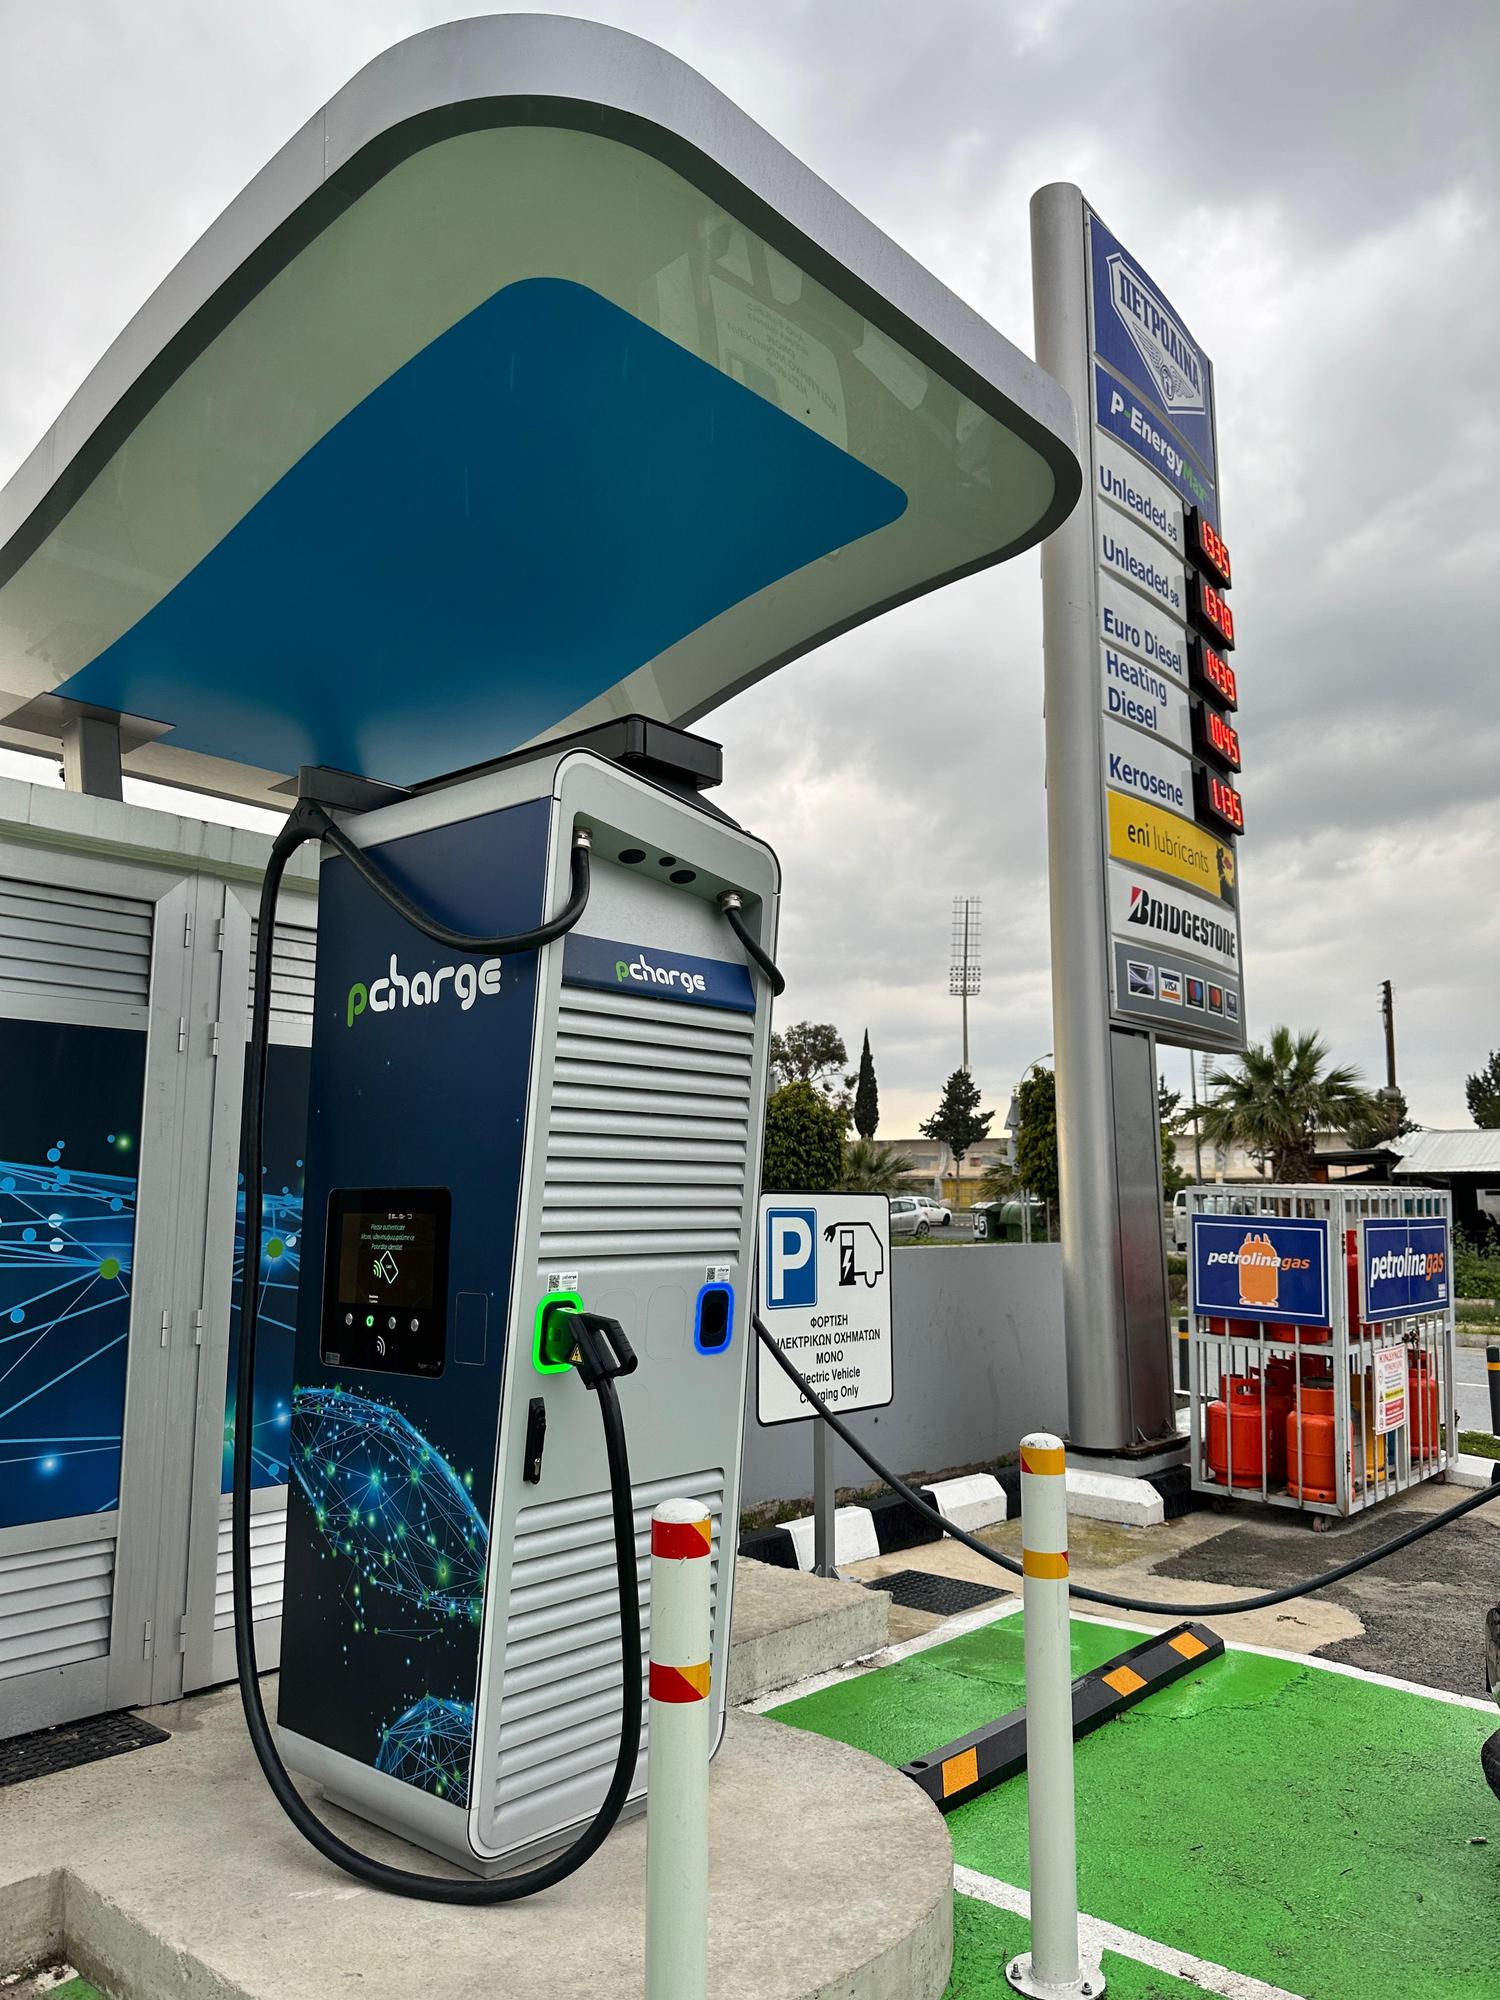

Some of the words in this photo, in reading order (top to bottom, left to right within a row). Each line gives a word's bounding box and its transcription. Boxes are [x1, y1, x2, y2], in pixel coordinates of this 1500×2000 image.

[1119, 269, 1201, 396] ΠΕΤΡΟΛΙΝΑ
[1100, 465, 1167, 532] Unleaded
[1167, 523, 1178, 542] 95
[1103, 534, 1169, 599] Unleaded
[1169, 588, 1180, 608] 98
[1103, 607, 1140, 648] Euro
[1144, 633, 1182, 676] Diesel
[1106, 649, 1168, 707] Heating
[1108, 686, 1157, 731] Diesel
[1109, 753, 1184, 807] Kerosene
[1127, 822, 1150, 848] eni
[1152, 824, 1209, 874] lubricants
[1127, 887, 1235, 959] BRIDGESTONE
[346, 953, 502, 1028] pcharge
[615, 954, 706, 994] pcharge
[1164, 980, 1177, 993] VISA
[771, 1216, 812, 1300] P
[810, 1313, 848, 1329] ΦΟΡΤΙΣΗ
[833, 1328, 881, 1345] ΟΧΗΜΑΤΩΝ
[816, 1350, 844, 1364] ΜΟΝΟ
[831, 1366, 861, 1381] Vehicle
[799, 1388, 839, 1404] Crging
[840, 1384, 859, 1399] Only
